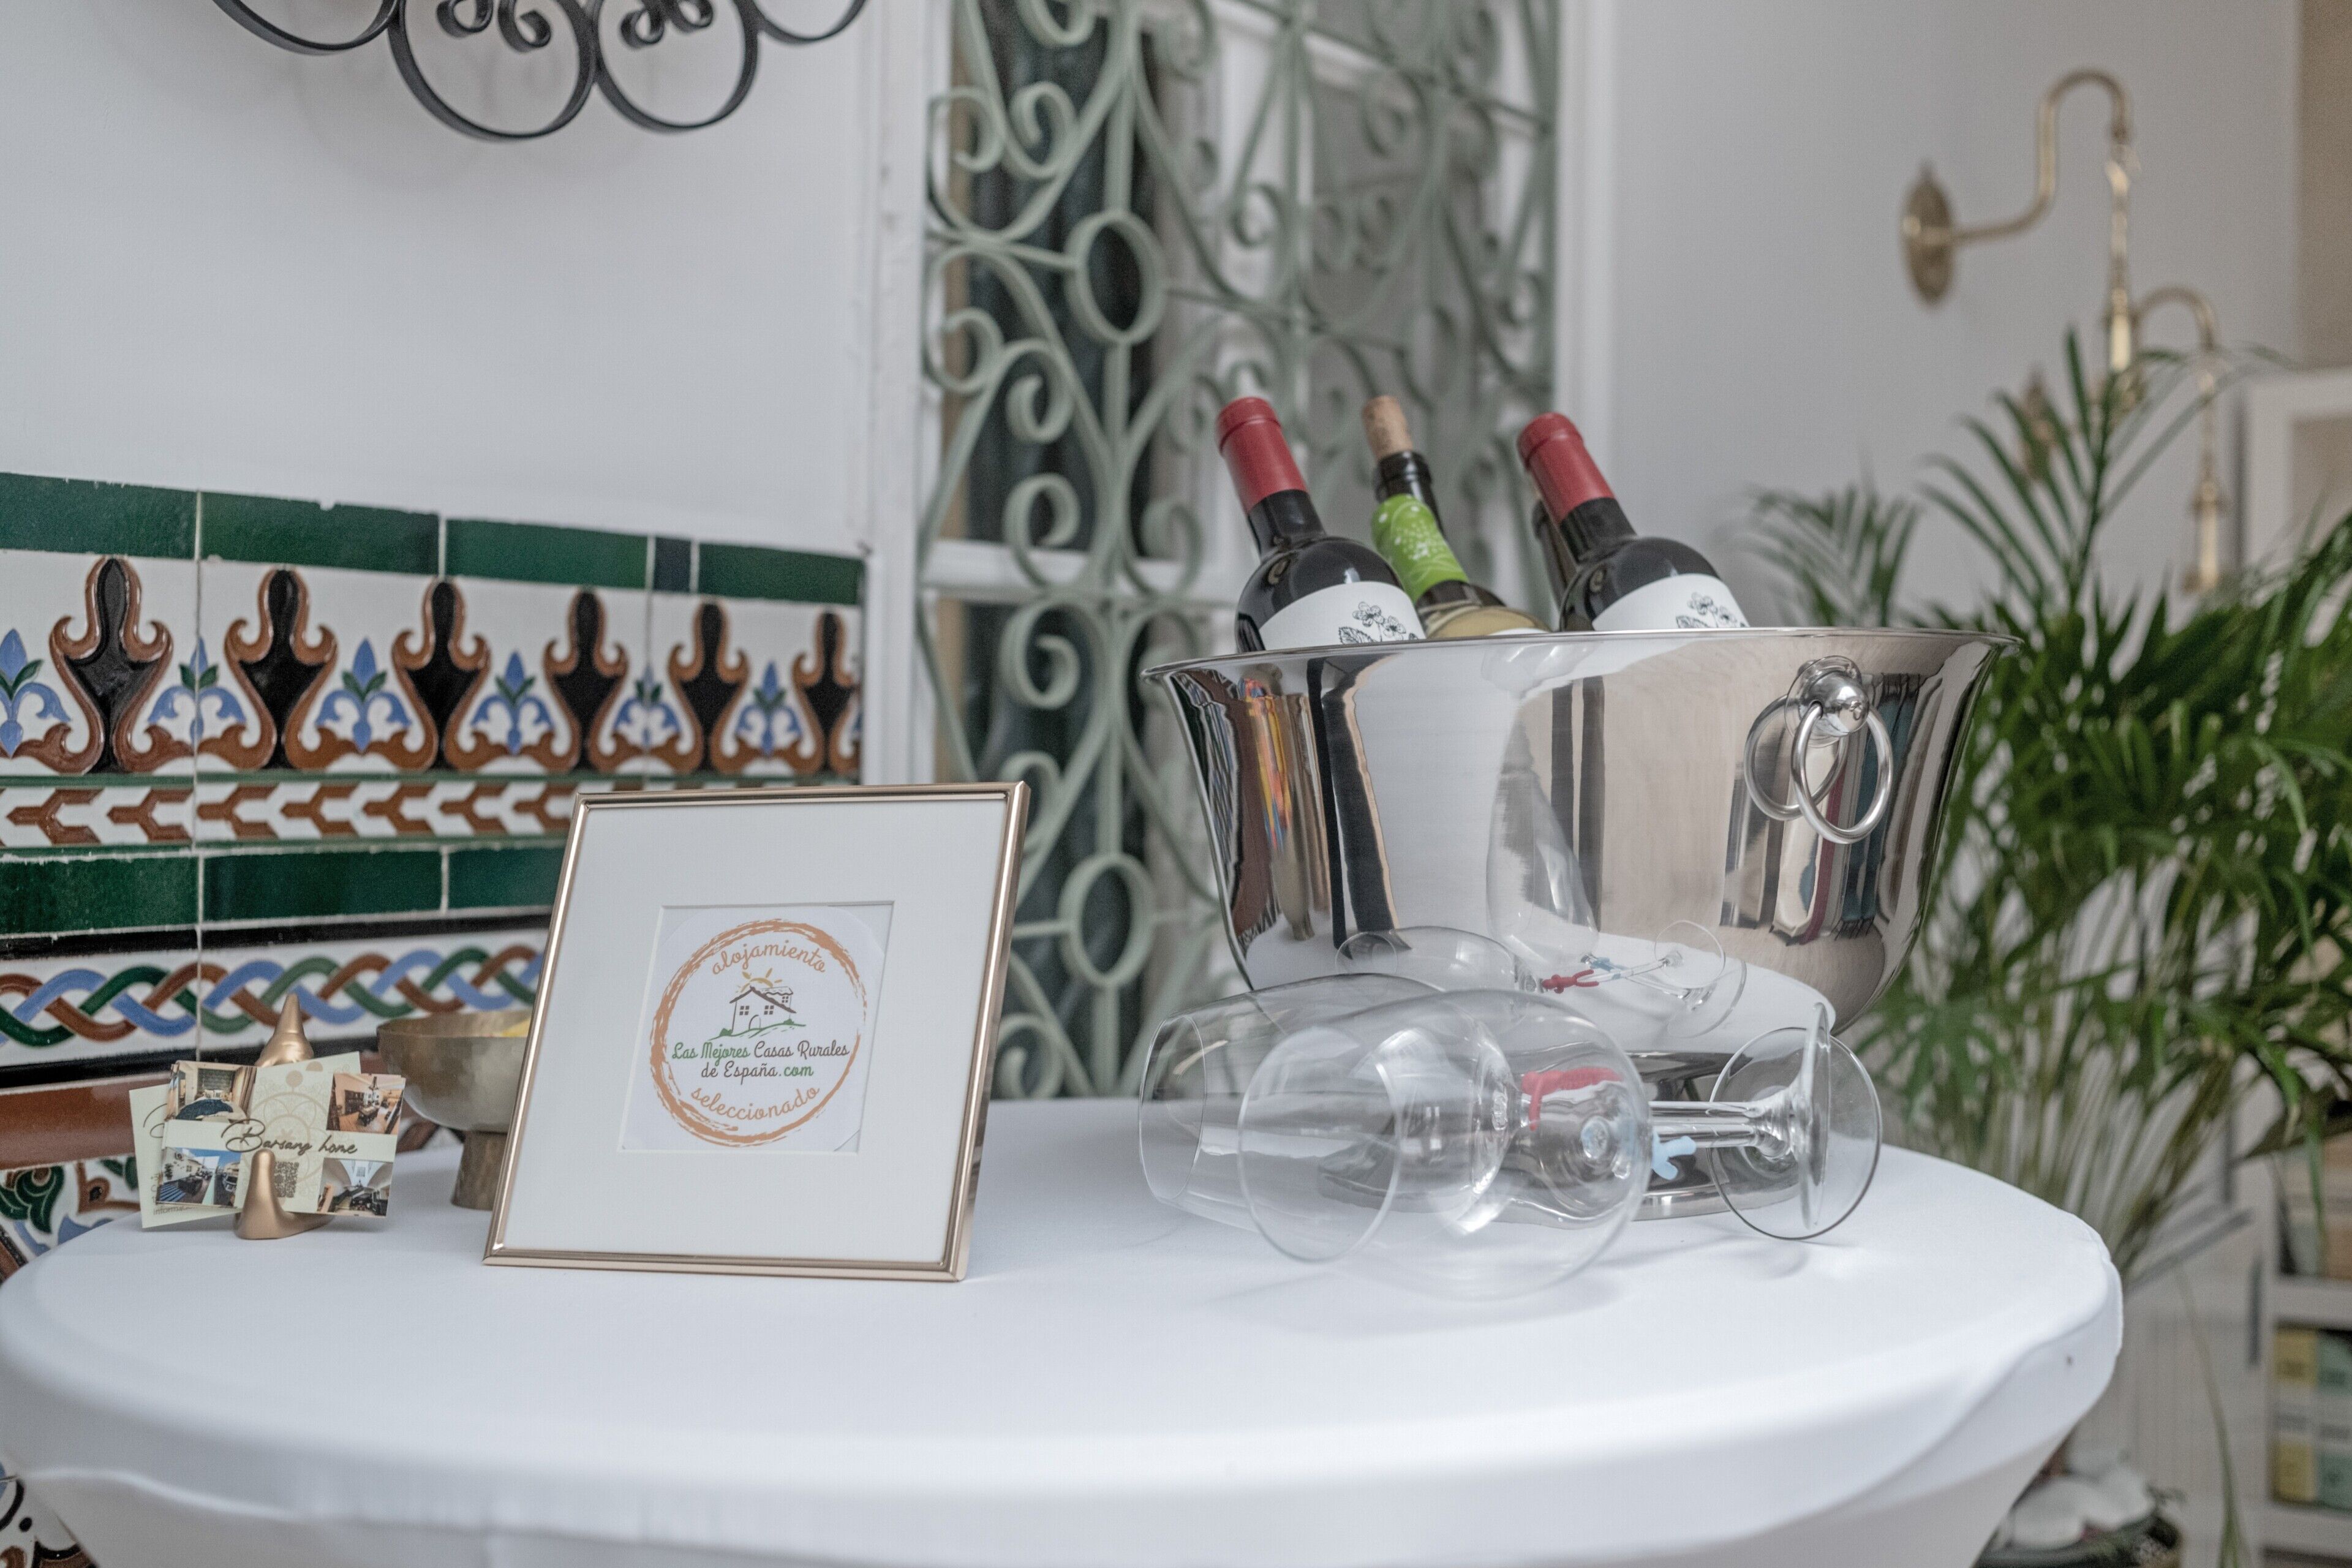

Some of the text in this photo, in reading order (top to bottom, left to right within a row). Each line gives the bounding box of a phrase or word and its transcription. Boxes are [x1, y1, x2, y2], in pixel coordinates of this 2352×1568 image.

[712, 939, 826, 975] alojamiento
[671, 1039, 850, 1067] Las Mejores Casas Rurales
[701, 1061, 718, 1078] de
[690, 1085, 820, 1121] seleccionado
[318, 1134, 358, 1155] home
